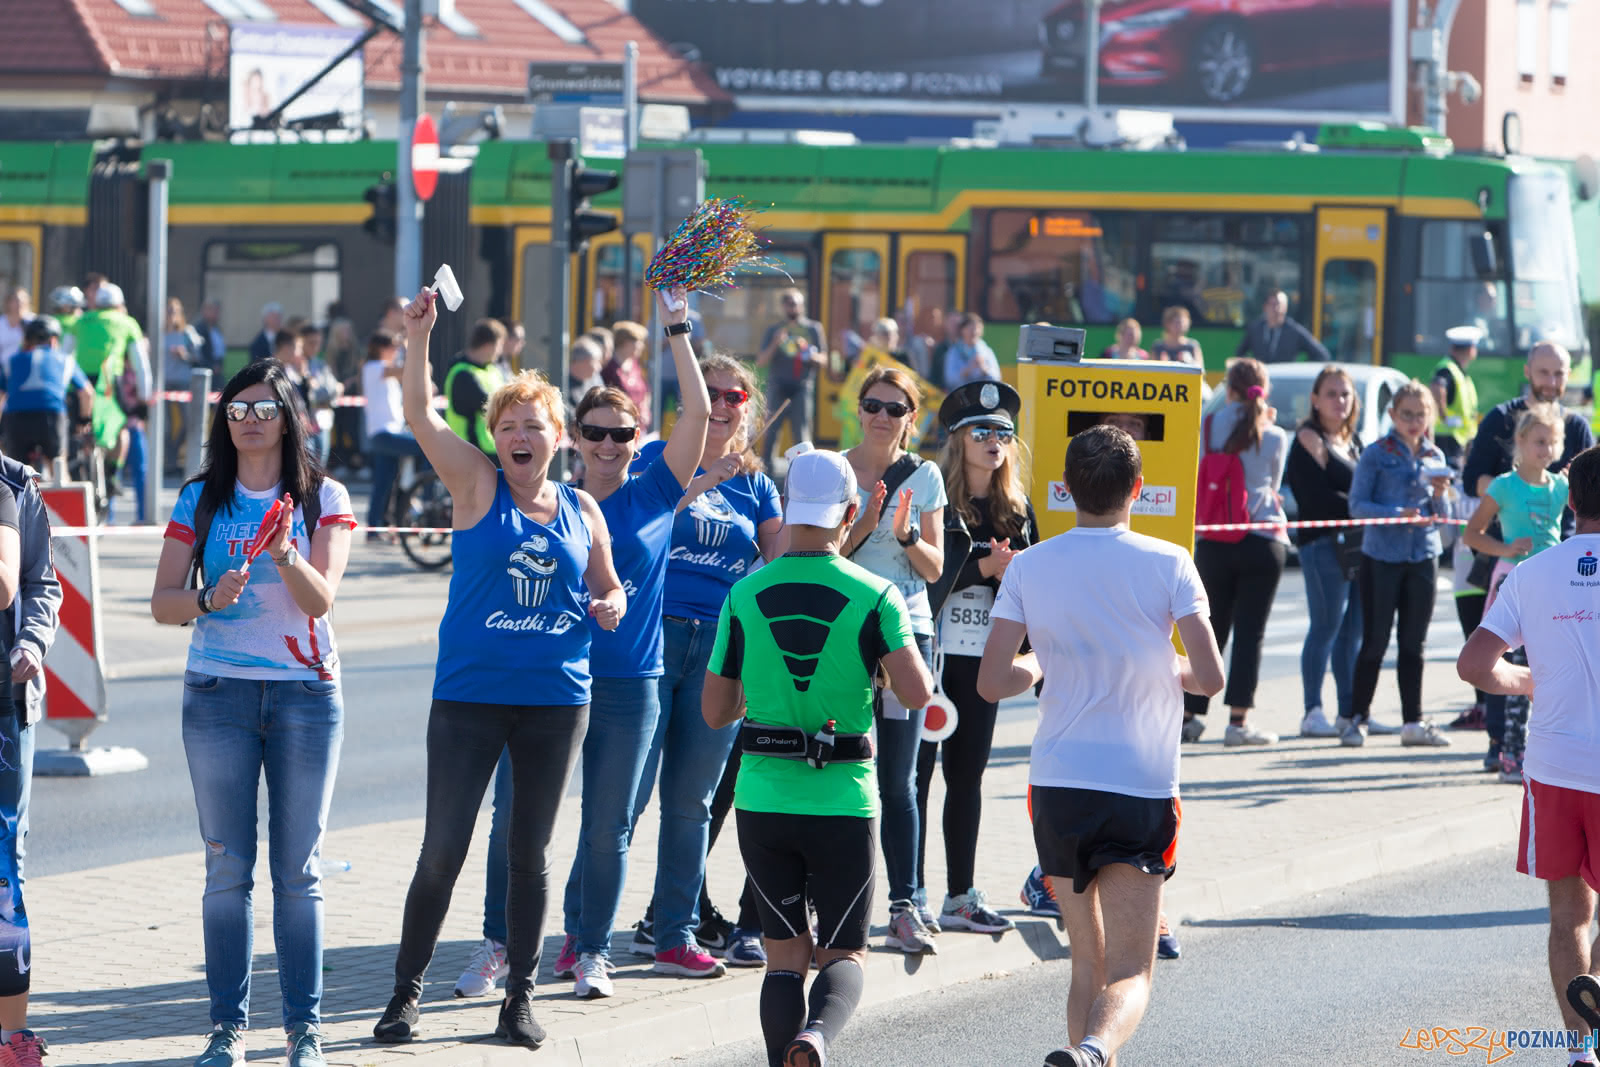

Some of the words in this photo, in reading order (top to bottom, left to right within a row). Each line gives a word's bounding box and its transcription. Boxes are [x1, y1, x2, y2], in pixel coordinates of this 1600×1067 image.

[716, 67, 823, 90] VOYAGER
[827, 70, 908, 92] GROUP
[1046, 378, 1189, 403] FOTORADAR
[950, 607, 990, 627] 5838
